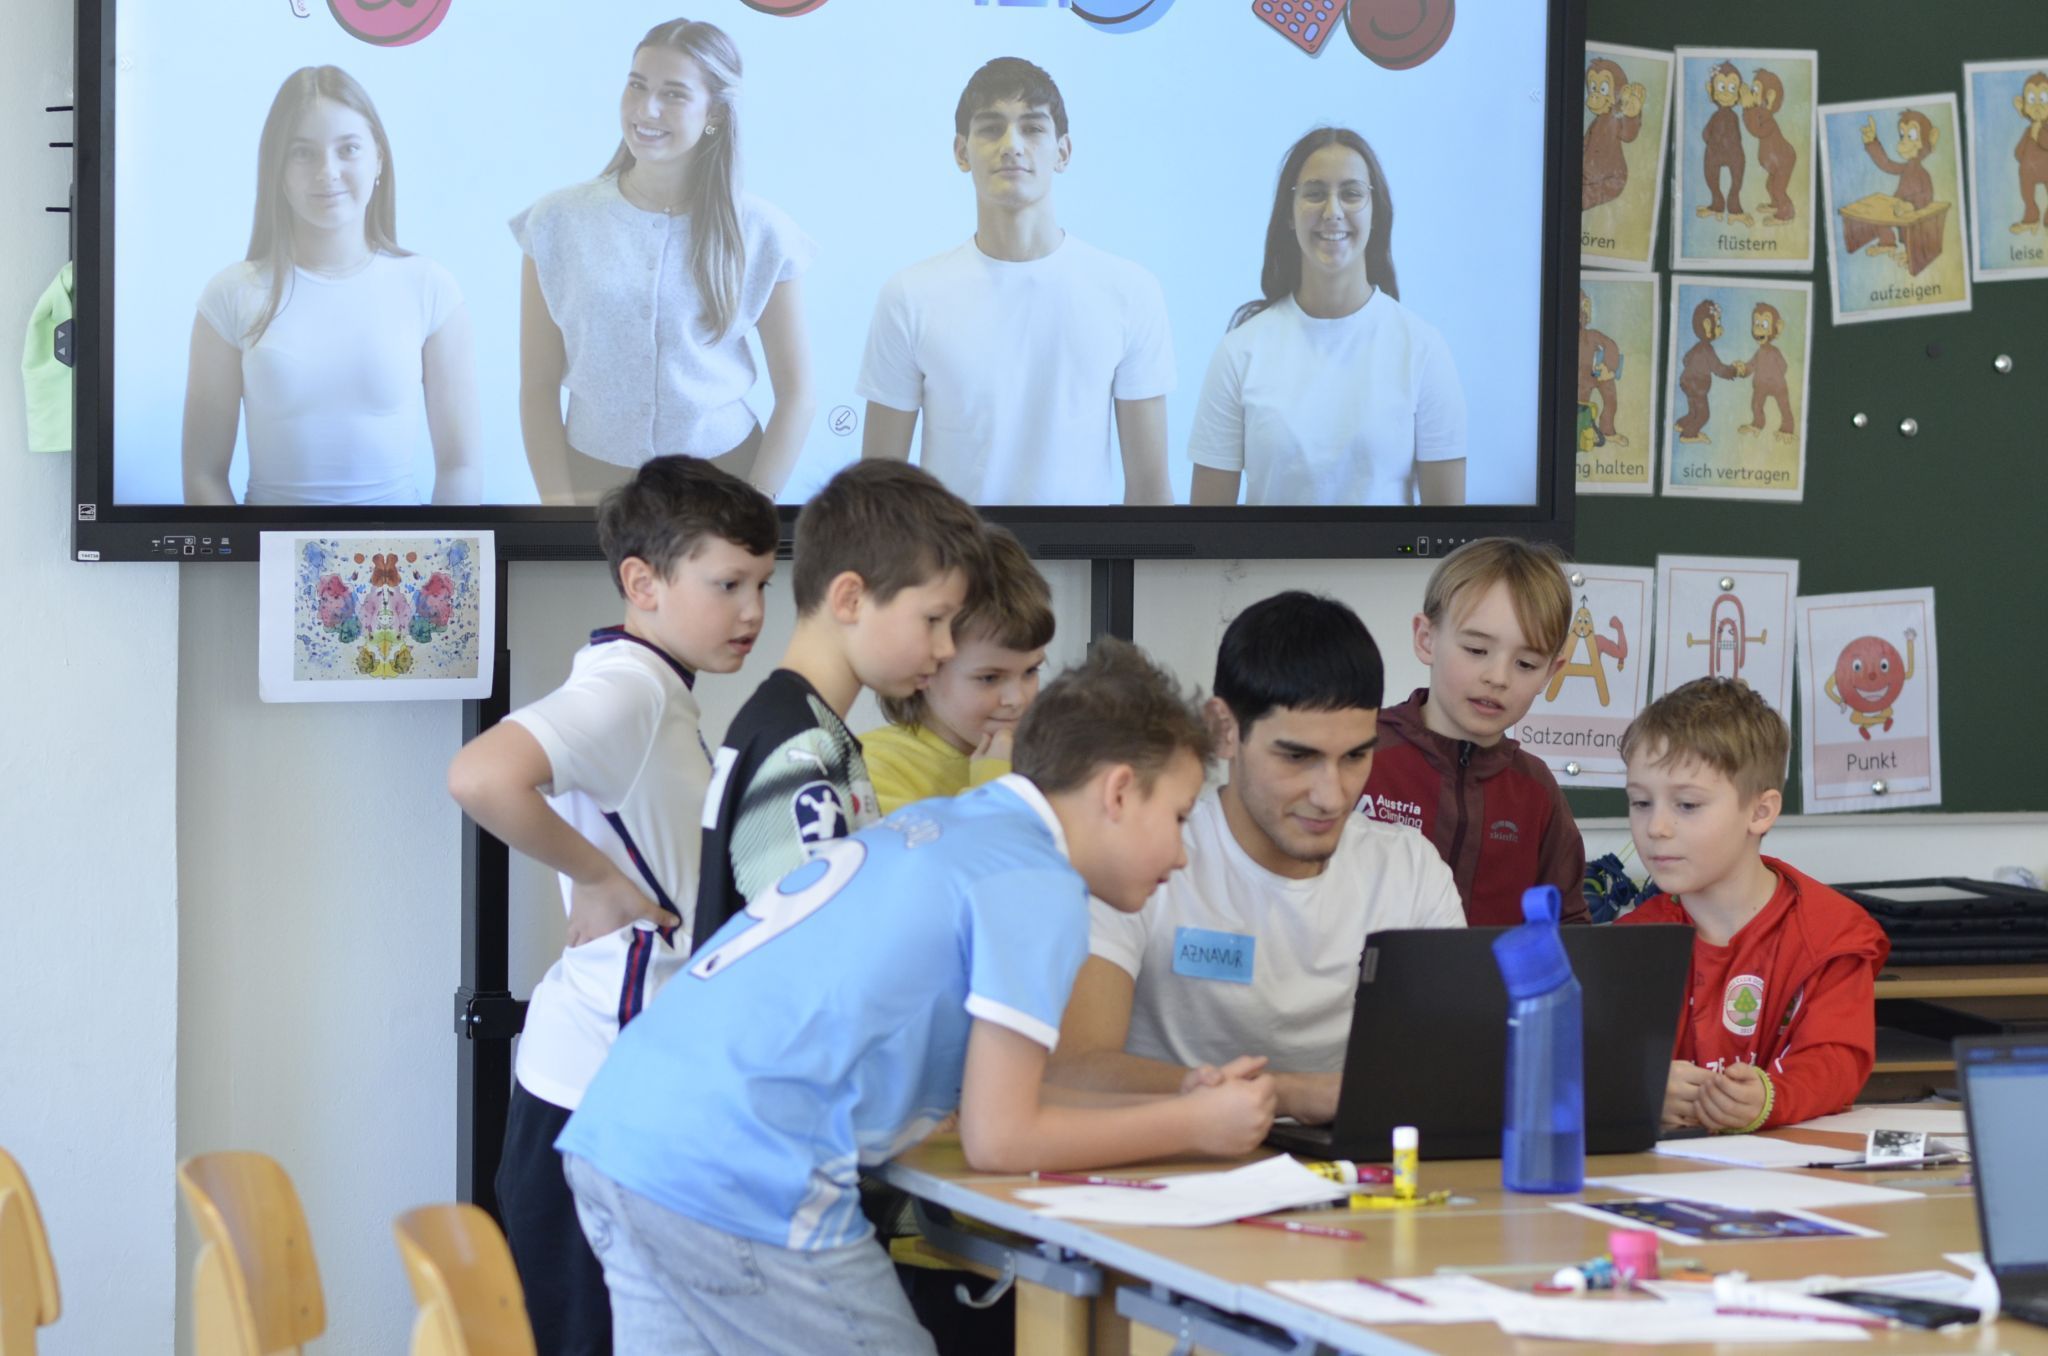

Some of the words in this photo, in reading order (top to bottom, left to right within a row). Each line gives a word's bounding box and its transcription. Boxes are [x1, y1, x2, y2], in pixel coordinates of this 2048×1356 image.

[1581, 232, 1615, 249] ören
[1717, 234, 1777, 251] flüstern
[2010, 245, 2044, 261] leise
[1869, 283, 1942, 302] aufzeigen
[1576, 462, 1591, 478] ng
[1595, 459, 1644, 475] halten
[1683, 464, 1712, 479] sich
[1717, 467, 1791, 485] vertragen
[1846, 751, 1898, 772] Punkt
[1376, 794, 1422, 815] Austria
[1378, 807, 1423, 829] Climbing
[687, 837, 868, 982] 9
[1180, 944, 1244, 968] AZNAVUR
